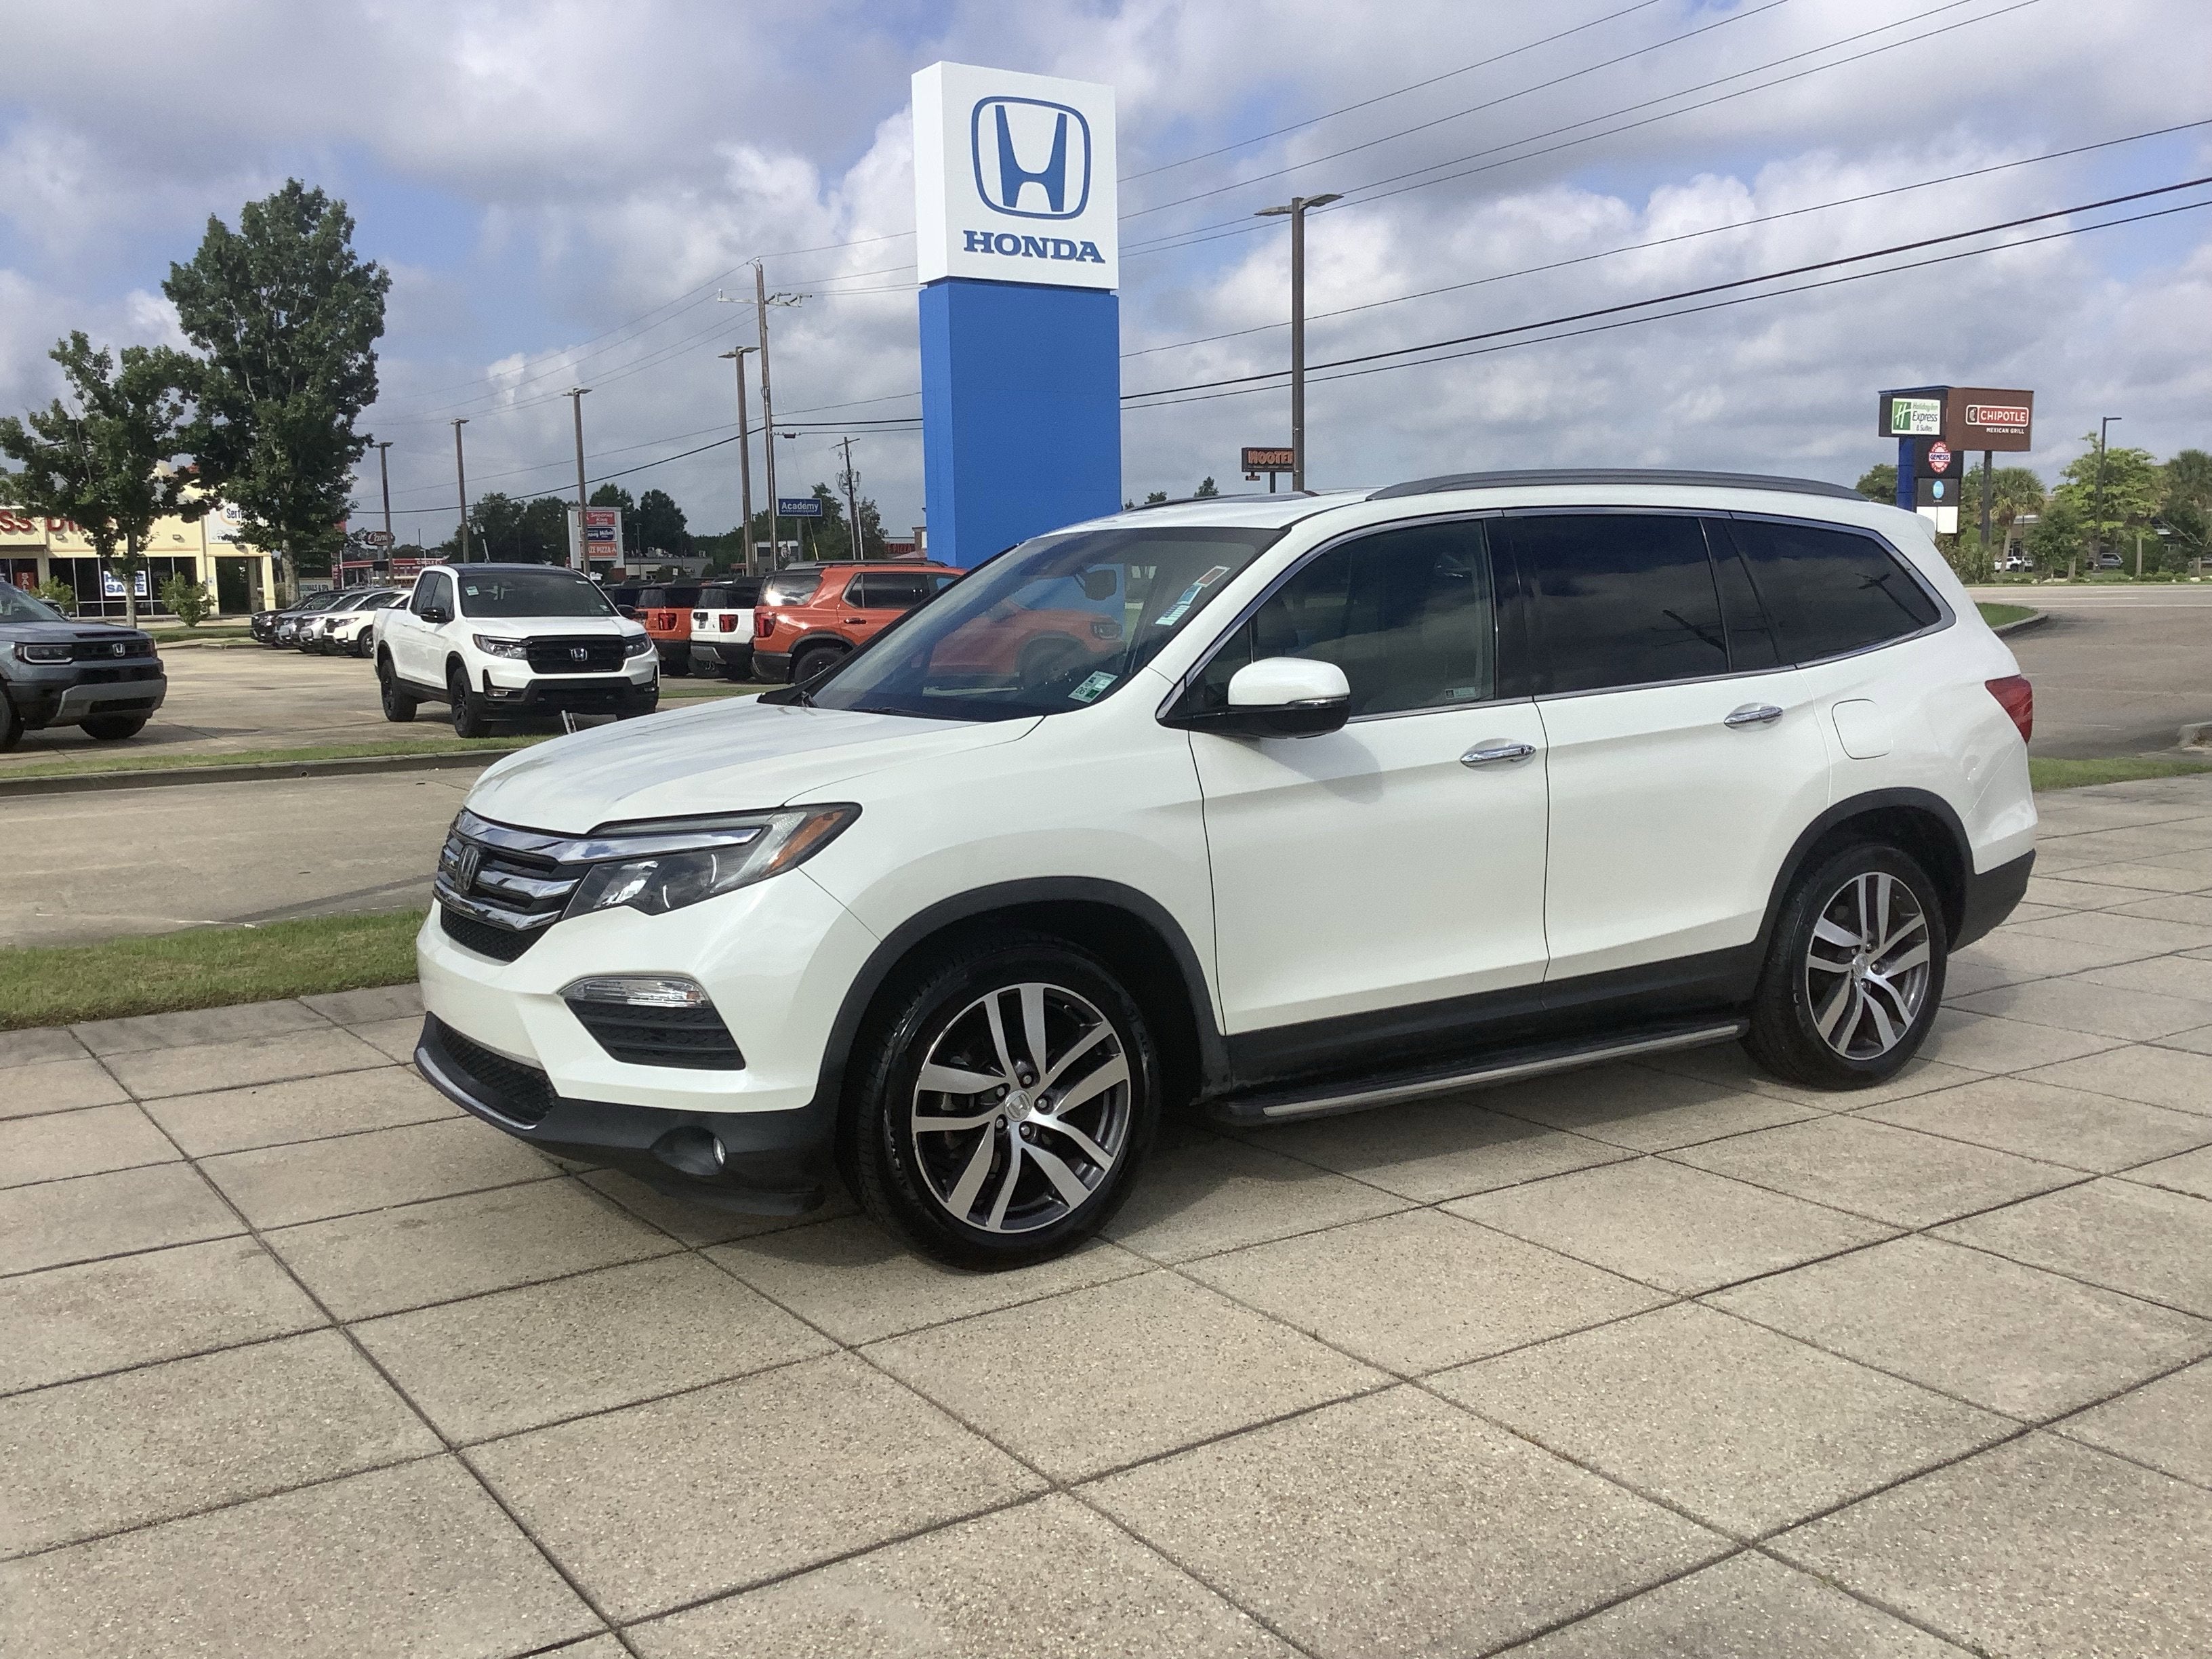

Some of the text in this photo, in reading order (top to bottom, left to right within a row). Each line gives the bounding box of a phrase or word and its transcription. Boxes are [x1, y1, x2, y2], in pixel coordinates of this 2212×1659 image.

[963, 230, 1105, 264] HONDA
[1912, 411, 1938, 424] Express
[1980, 411, 2026, 422] CHIPOTLE
[781, 502, 819, 512] Academy
